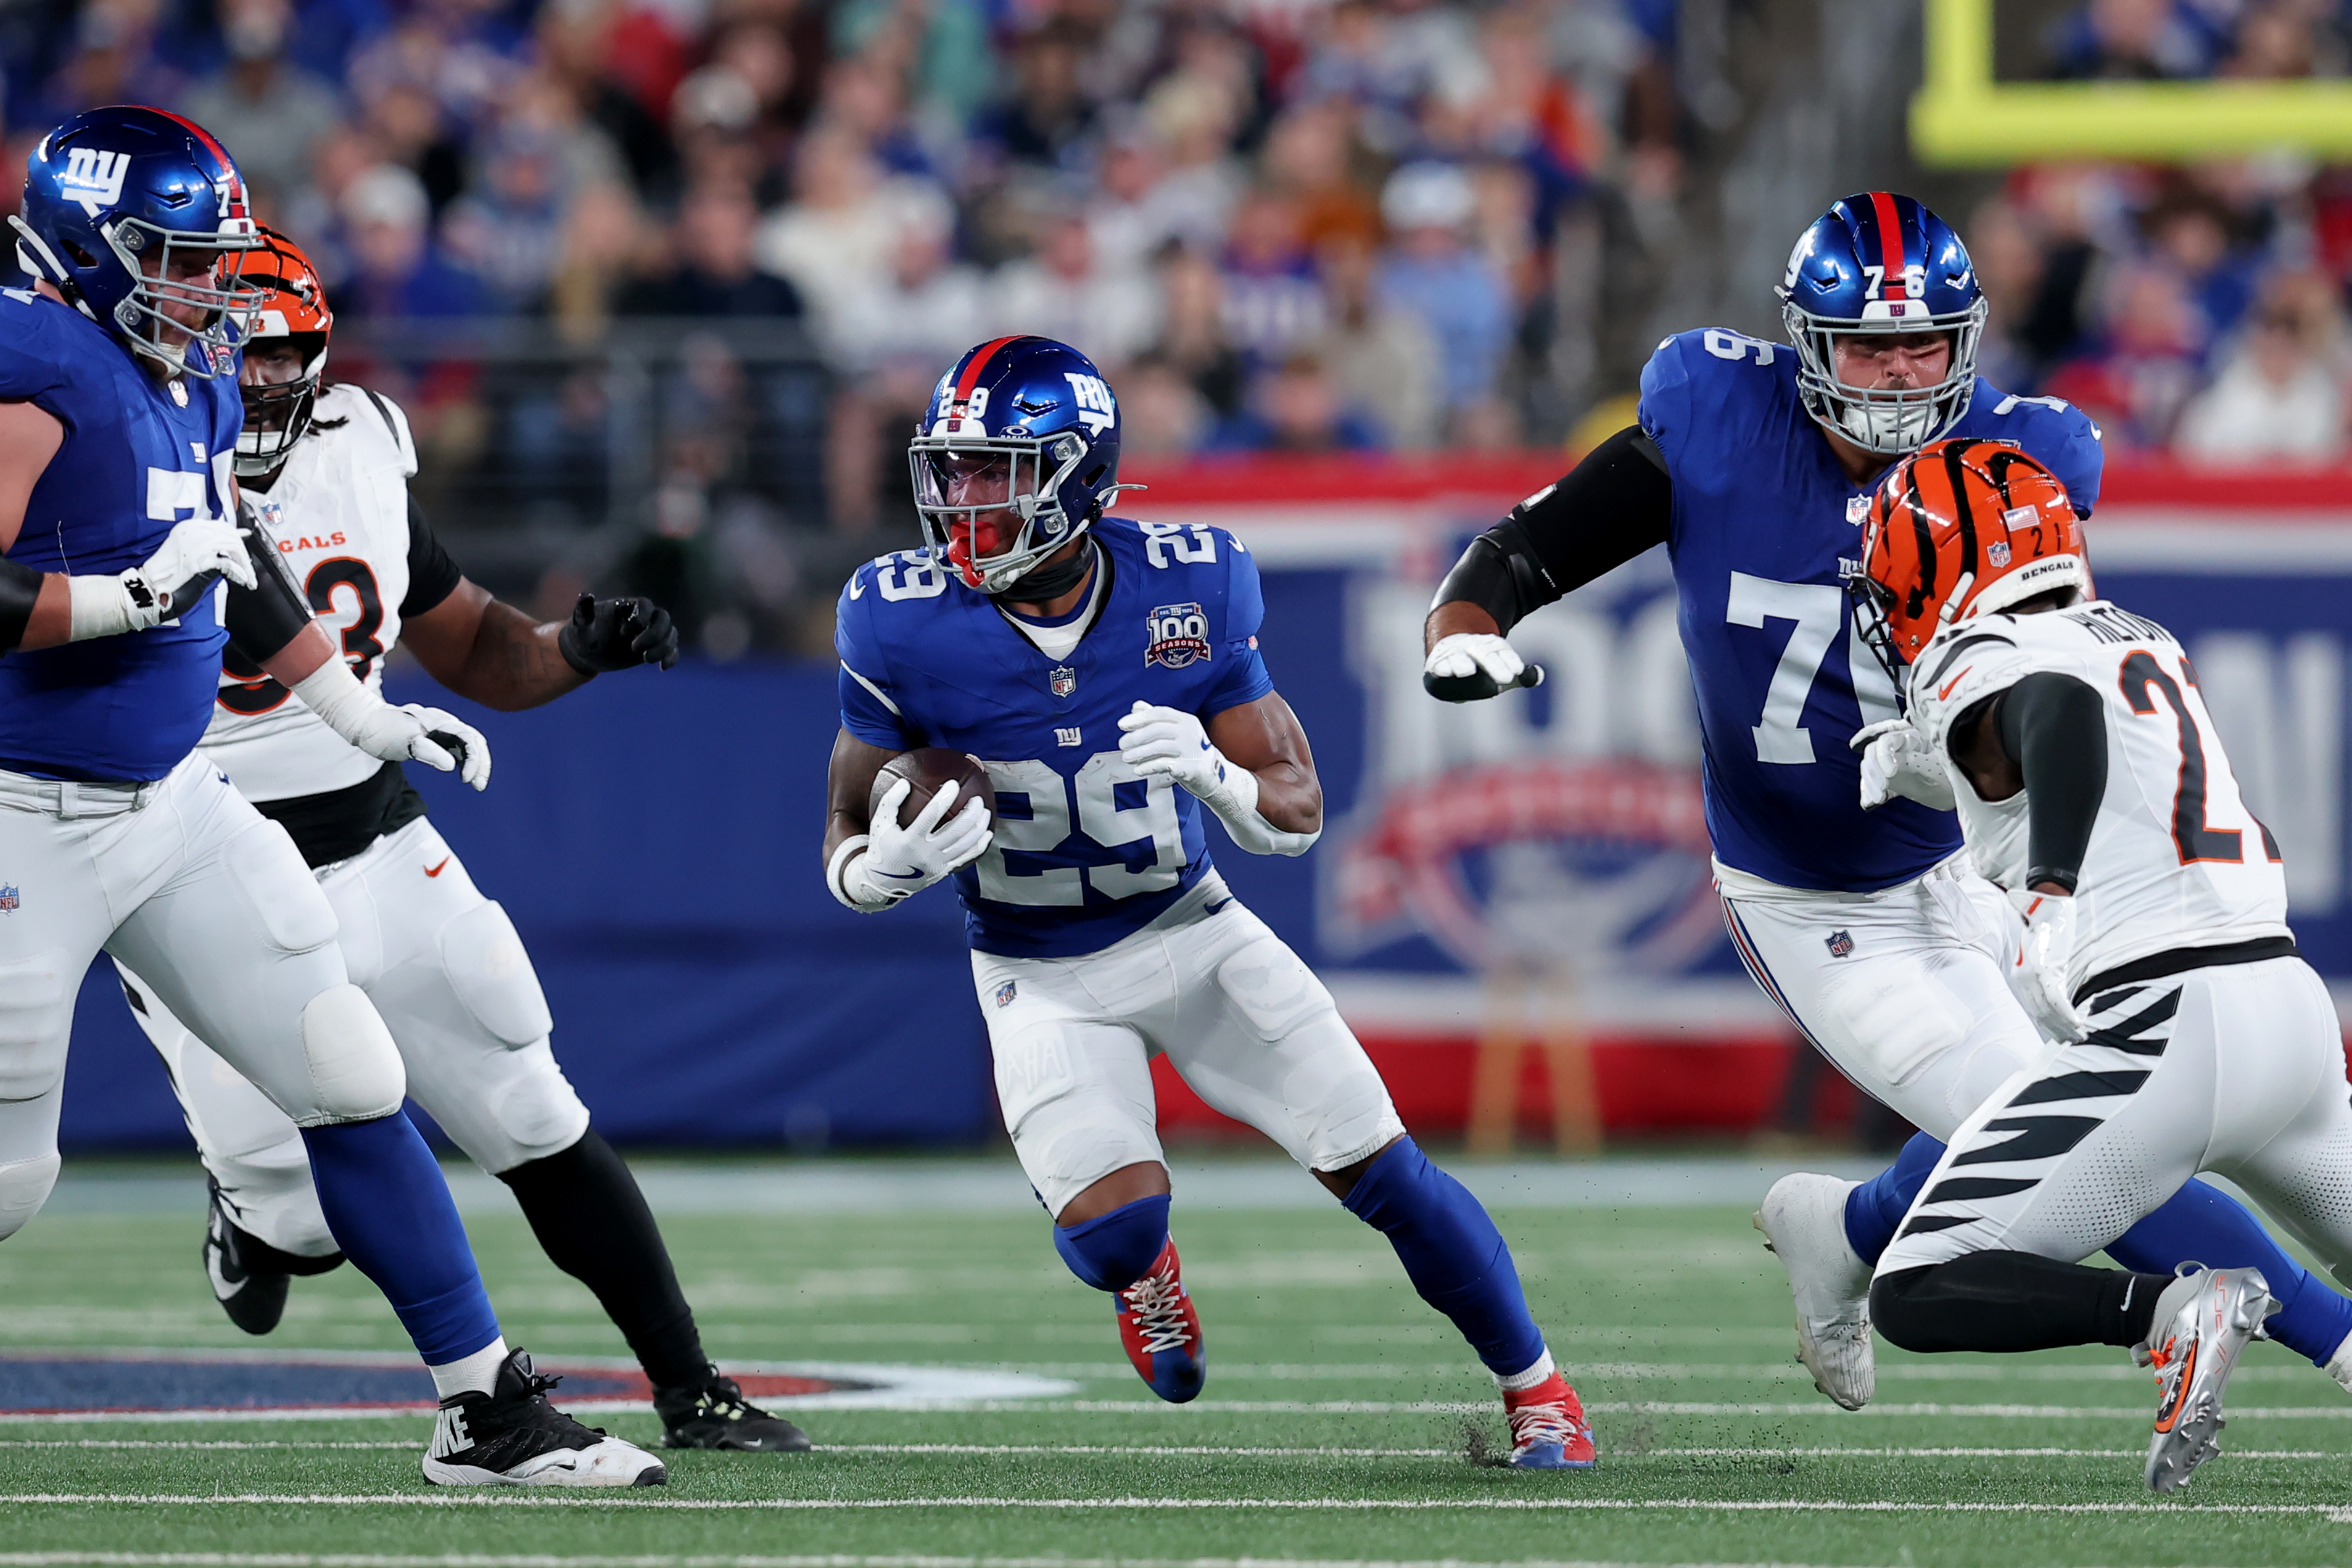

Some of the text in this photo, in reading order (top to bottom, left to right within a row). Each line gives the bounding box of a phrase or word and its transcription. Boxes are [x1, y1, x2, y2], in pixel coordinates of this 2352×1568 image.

[1863, 265, 1925, 300] 76
[937, 387, 990, 419] 29
[278, 531, 347, 553] GALS
[2031, 523, 2061, 557] 21
[2021, 561, 2074, 581] BENGALS
[1149, 615, 1205, 645] 100
[1155, 640, 1200, 651] SEASONS
[976, 750, 1187, 906] 29
[1833, 940, 1851, 954] NFL
[999, 990, 1015, 1004] NFL
